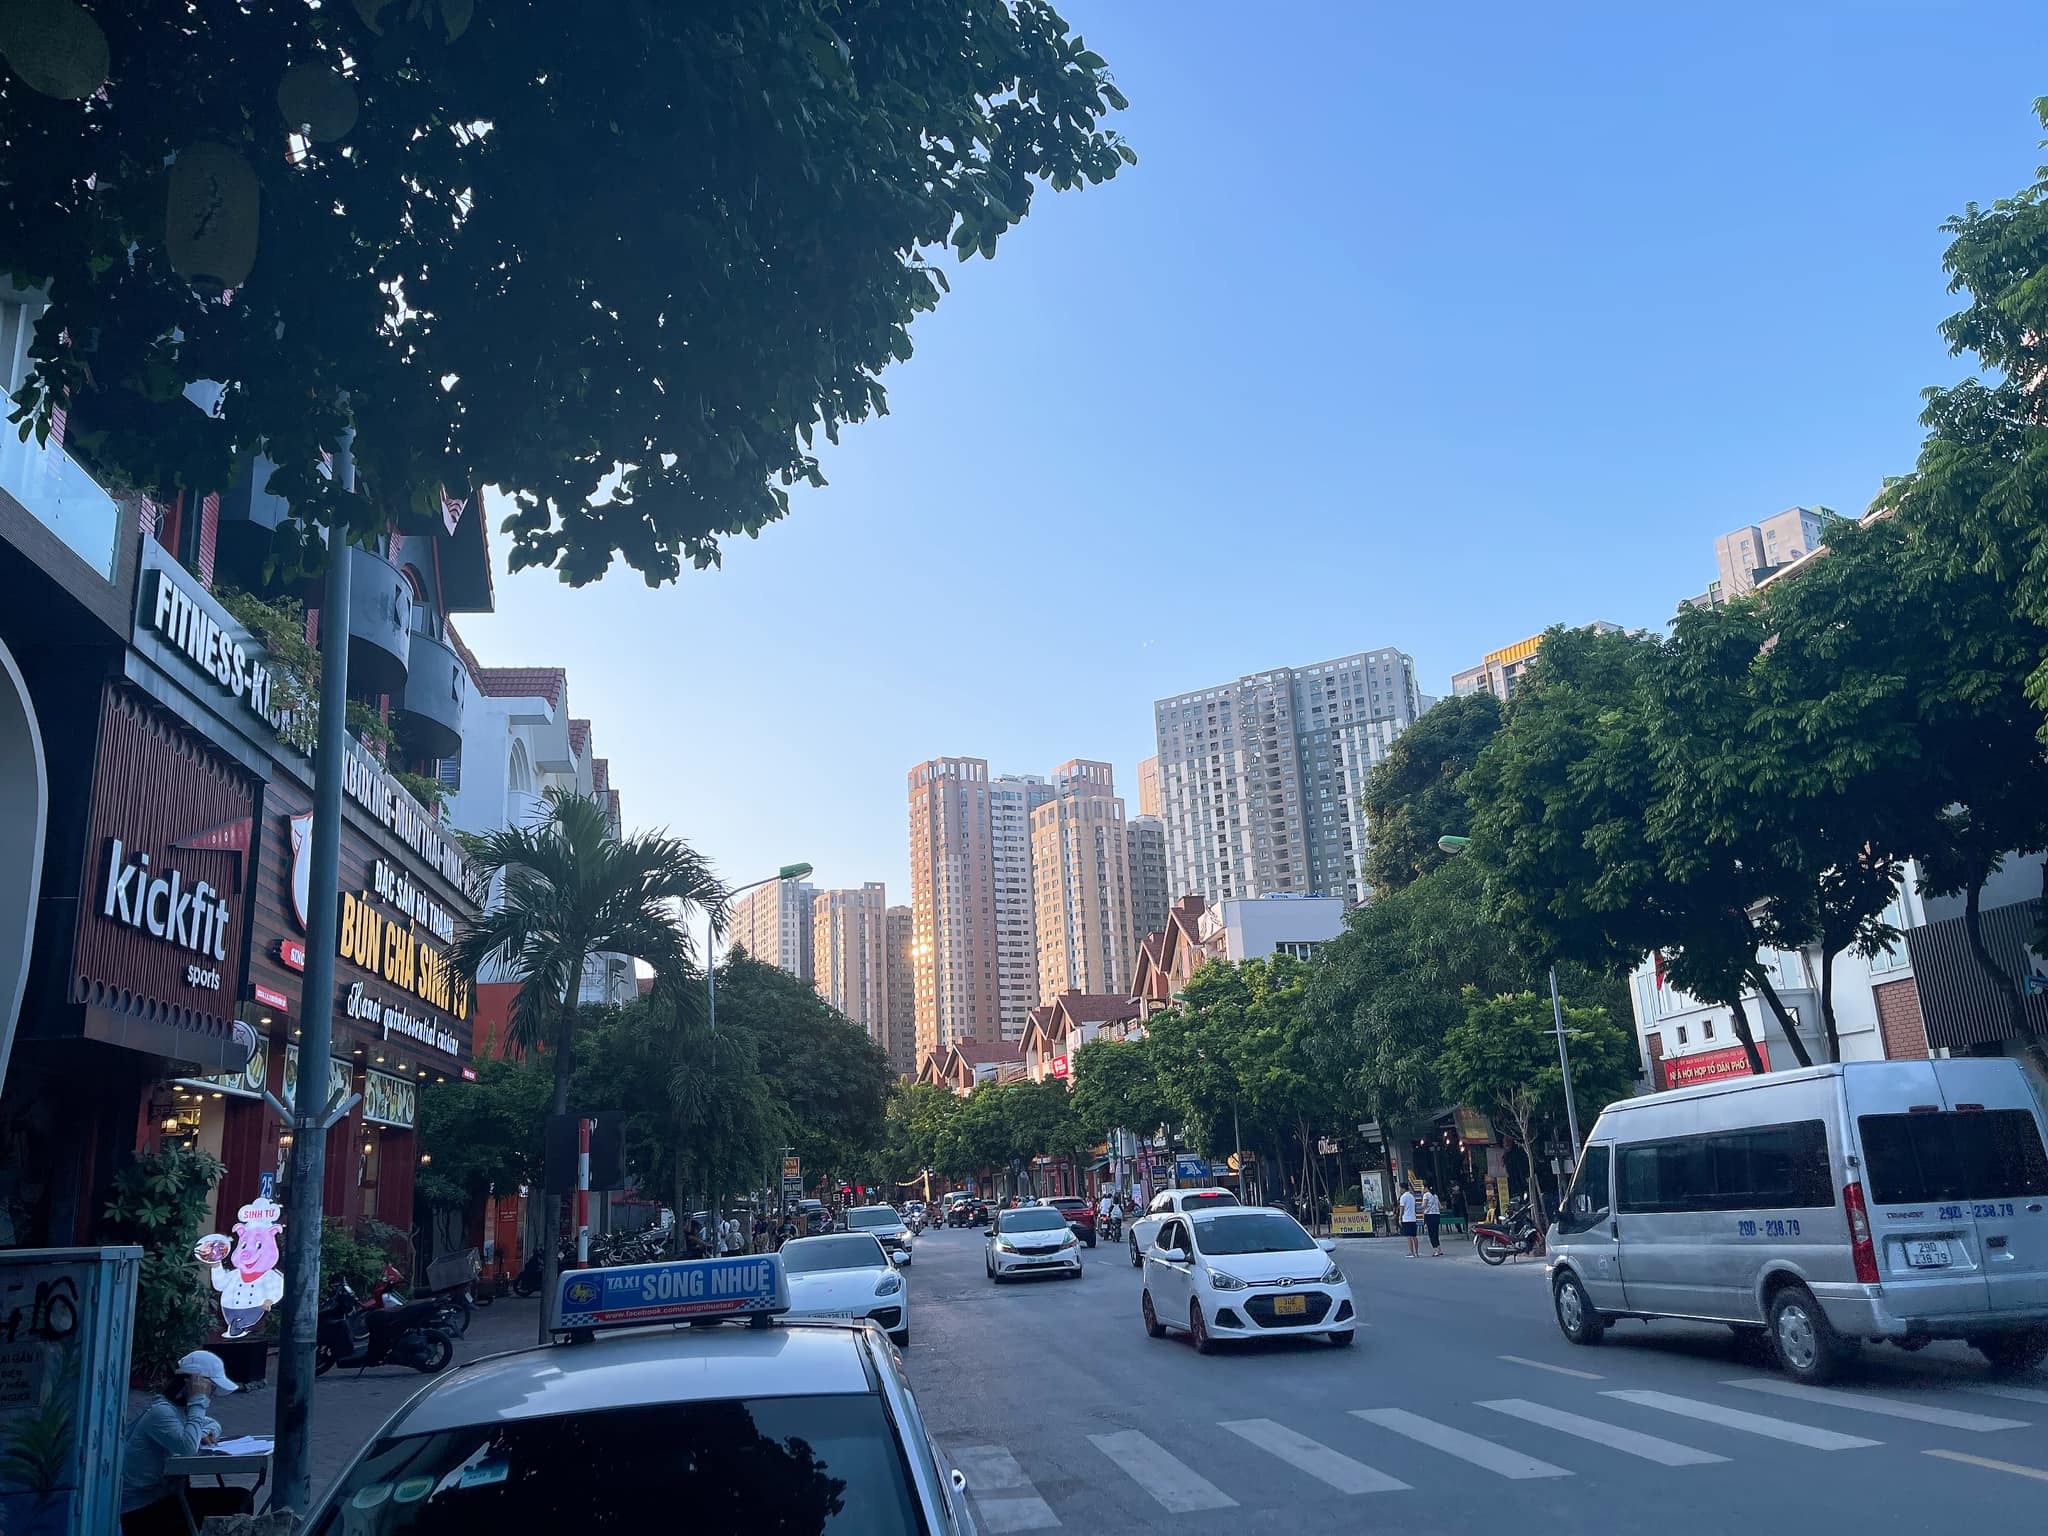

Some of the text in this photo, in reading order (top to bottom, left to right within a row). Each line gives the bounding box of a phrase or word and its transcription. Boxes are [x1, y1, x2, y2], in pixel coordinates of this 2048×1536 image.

[104, 839, 229, 961] kickfit
[375, 858, 395, 904] ĐẶC
[396, 871, 416, 917] SẢN
[416, 890, 428, 928] HÀ
[340, 890, 382, 975] BÚN
[384, 919, 415, 993] CHẢ
[187, 964, 220, 990] sports
[347, 981, 381, 1024] Hanoi
[383, 1004, 436, 1047] quintessential
[1669, 1069, 1682, 1081] NÀ
[1694, 1066, 1707, 1079] HỌP
[1717, 1061, 1731, 1073] DÂN
[1731, 1056, 1746, 1070] PHỐ
[261, 1175, 273, 1198] 25
[243, 1210, 263, 1219] SINH
[1938, 1206, 1963, 1220] 29D
[1974, 1203, 2014, 1218] 238.79
[1737, 1220, 1757, 1237] 29D
[1765, 1219, 1801, 1238] 238.79
[1919, 1241, 1937, 1253] 29D
[606, 1260, 771, 1301] TAXI SÔNG NHUỆ
